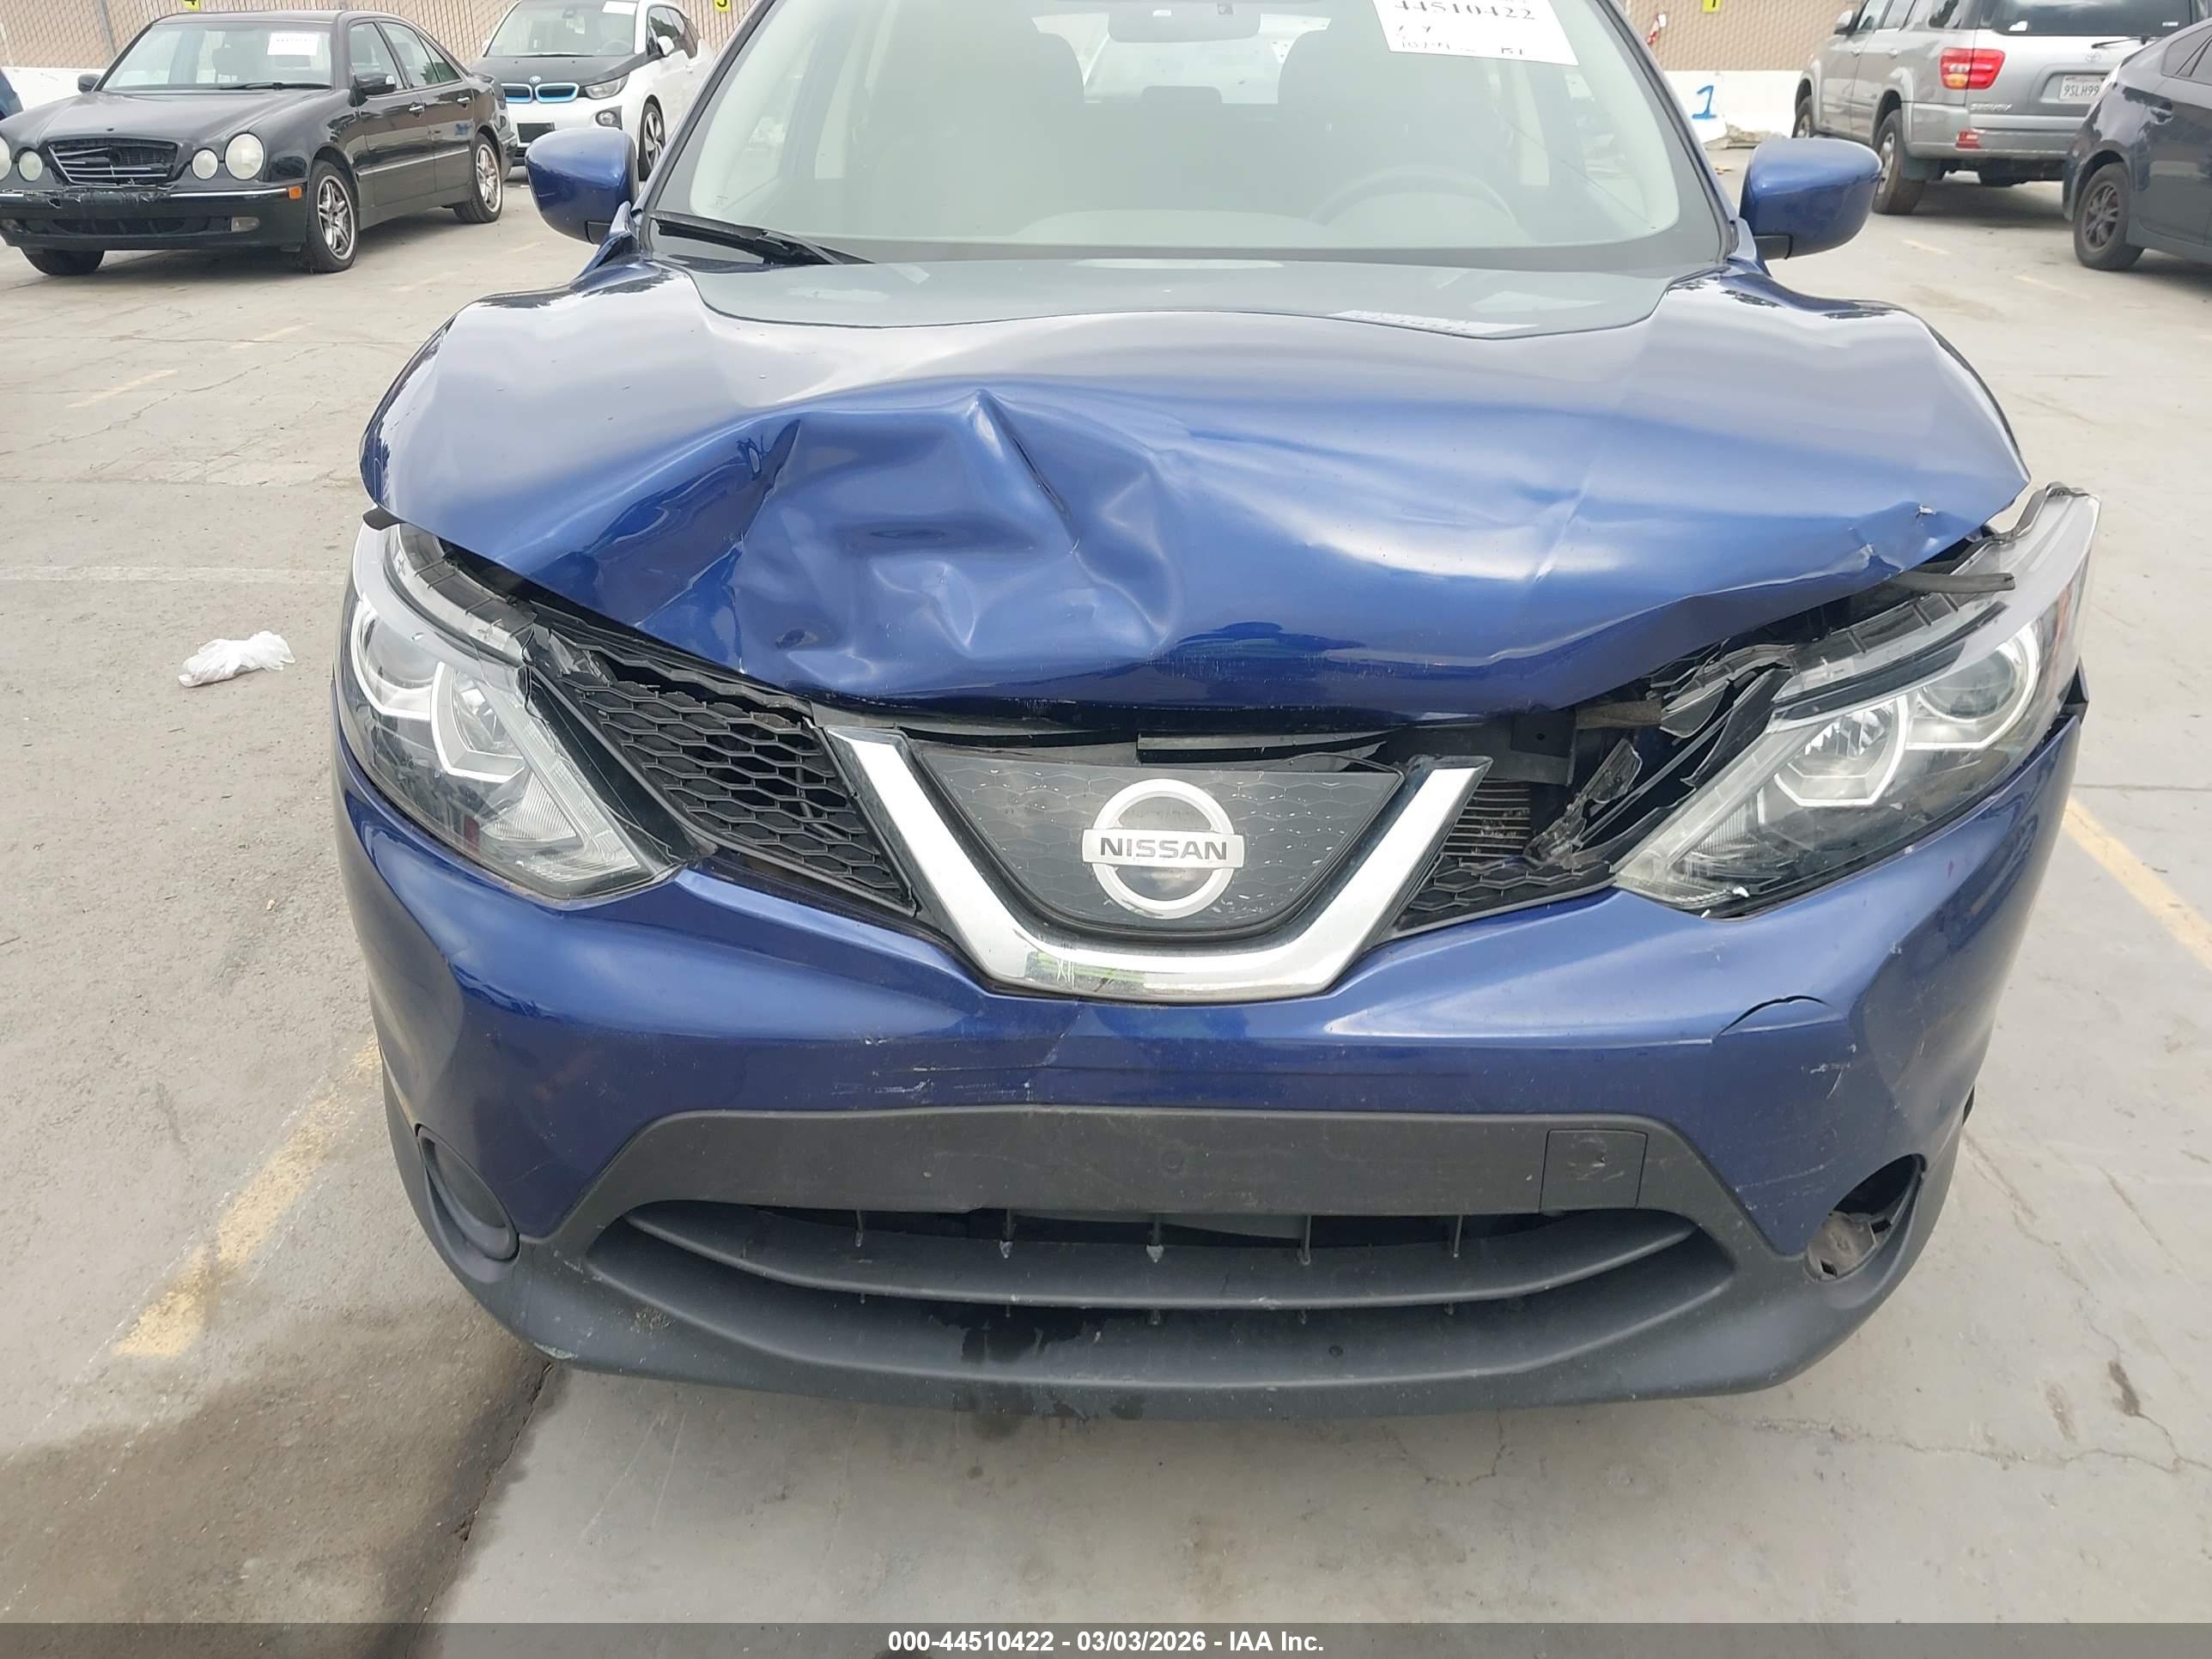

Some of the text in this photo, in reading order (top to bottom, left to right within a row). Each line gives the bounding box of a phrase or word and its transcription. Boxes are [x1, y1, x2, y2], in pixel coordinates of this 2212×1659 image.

[1692, 85, 1717, 119] 1
[2063, 84, 2100, 97] 9SLH99
[1099, 836, 1228, 860] NISSAN
